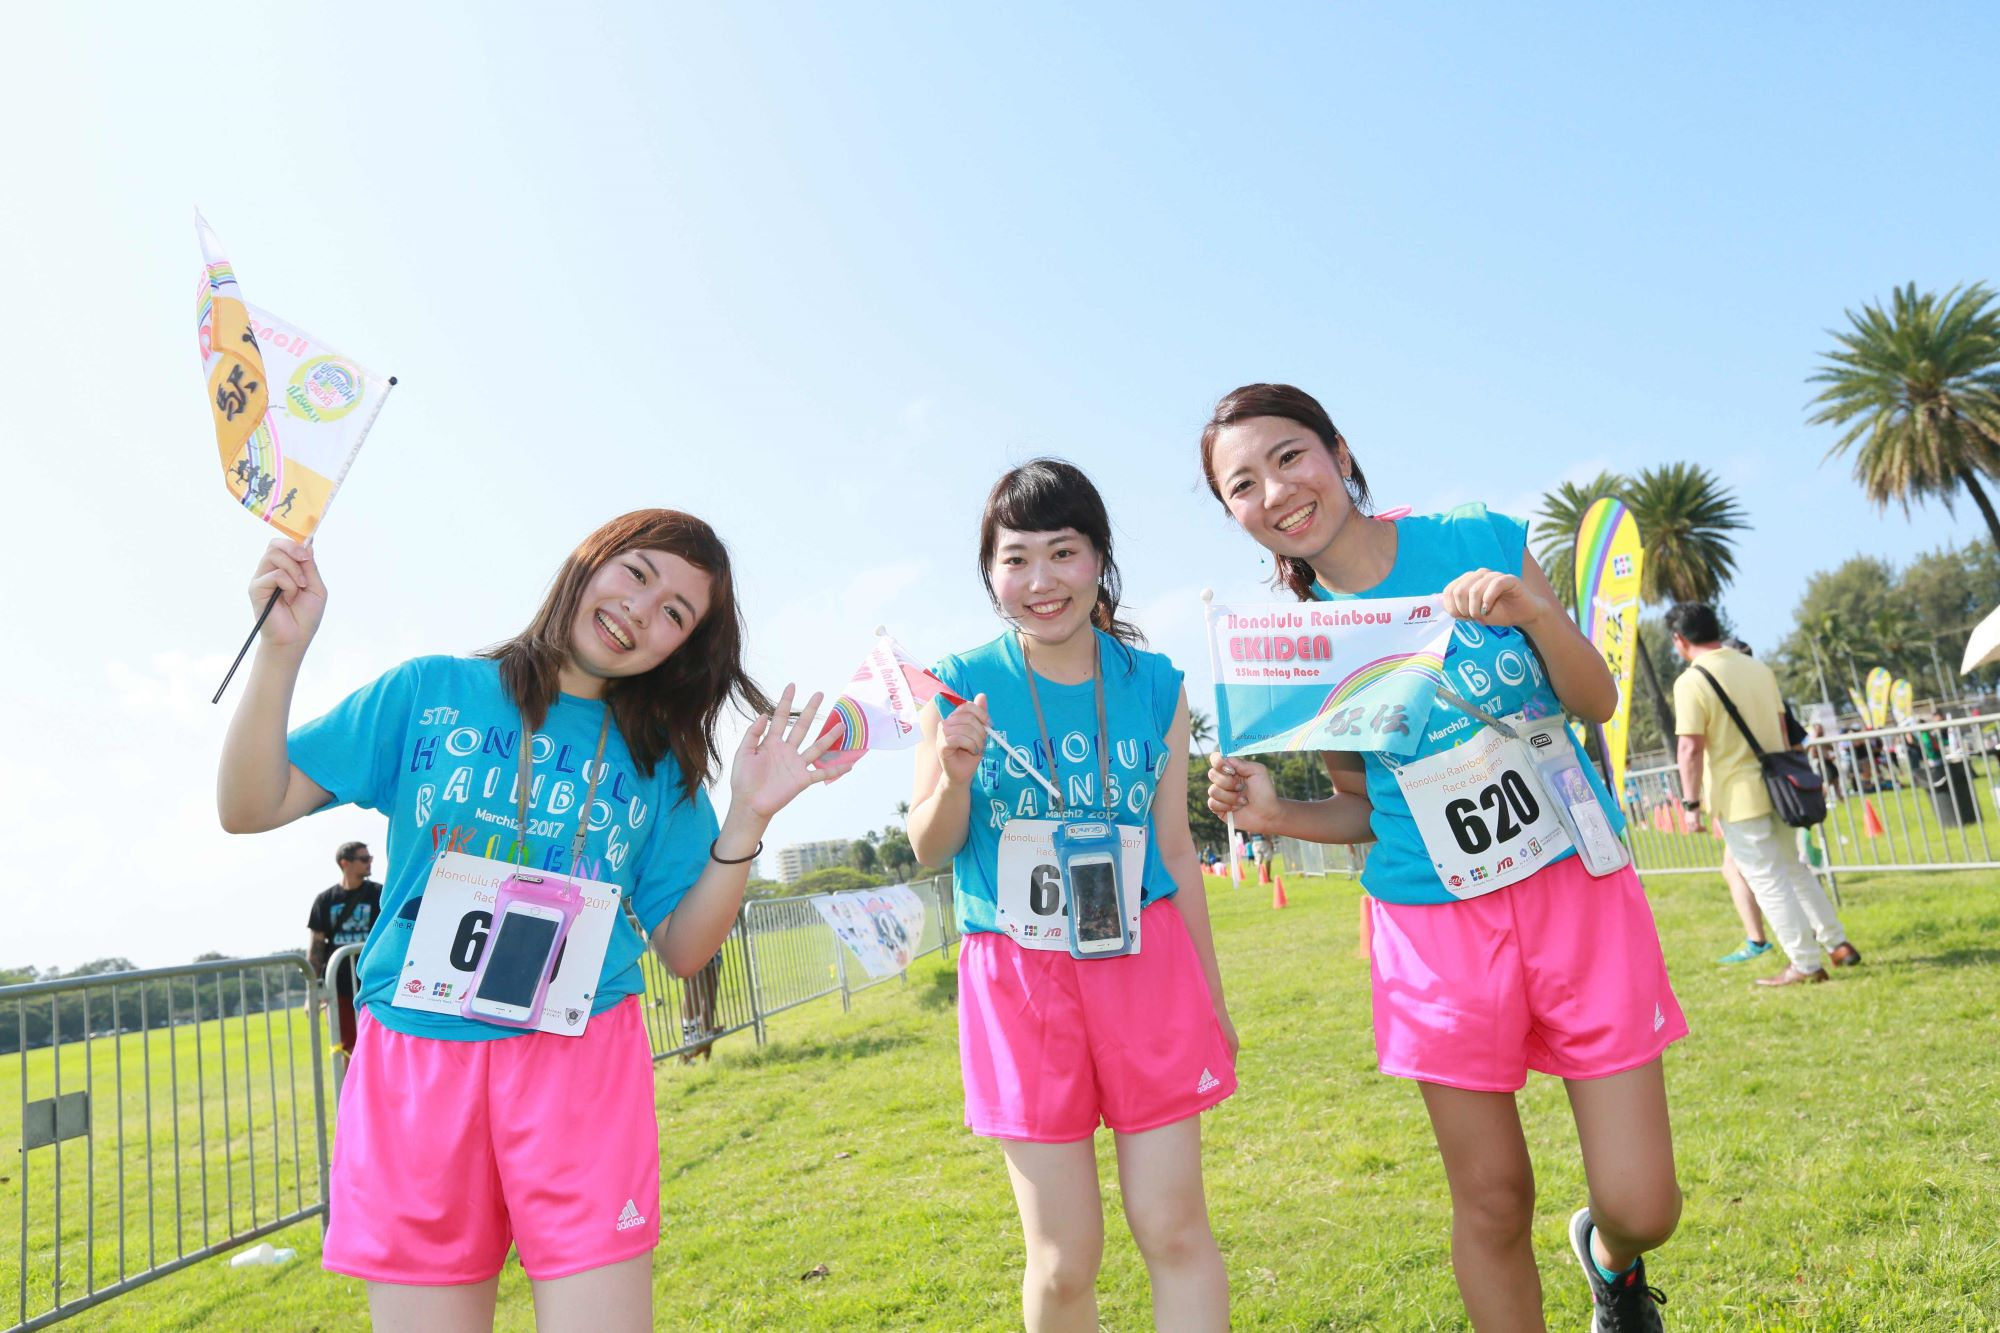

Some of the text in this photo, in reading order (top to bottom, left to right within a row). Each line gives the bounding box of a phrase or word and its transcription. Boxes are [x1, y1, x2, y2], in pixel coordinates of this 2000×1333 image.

[1228, 609, 1392, 630] Honolulu Rainbow
[1229, 635, 1333, 662] EKIDEN
[1235, 667, 1320, 680] 25km Relay Race
[419, 706, 460, 726] 5TH
[1427, 716, 1471, 743] March12
[1404, 771, 1446, 791] Honolulu
[1442, 780, 1467, 795] Race
[1469, 772, 1488, 786] day
[1445, 769, 1540, 855] 620
[526, 818, 565, 839] 2017
[1004, 833, 1045, 843] Honolulu
[1121, 839, 1142, 849] 2017
[1496, 856, 1514, 874] JTB
[435, 867, 488, 887] Honolulu
[473, 891, 496, 904] Rac
[584, 896, 611, 911] 2017
[616, 1216, 646, 1231] adidas
